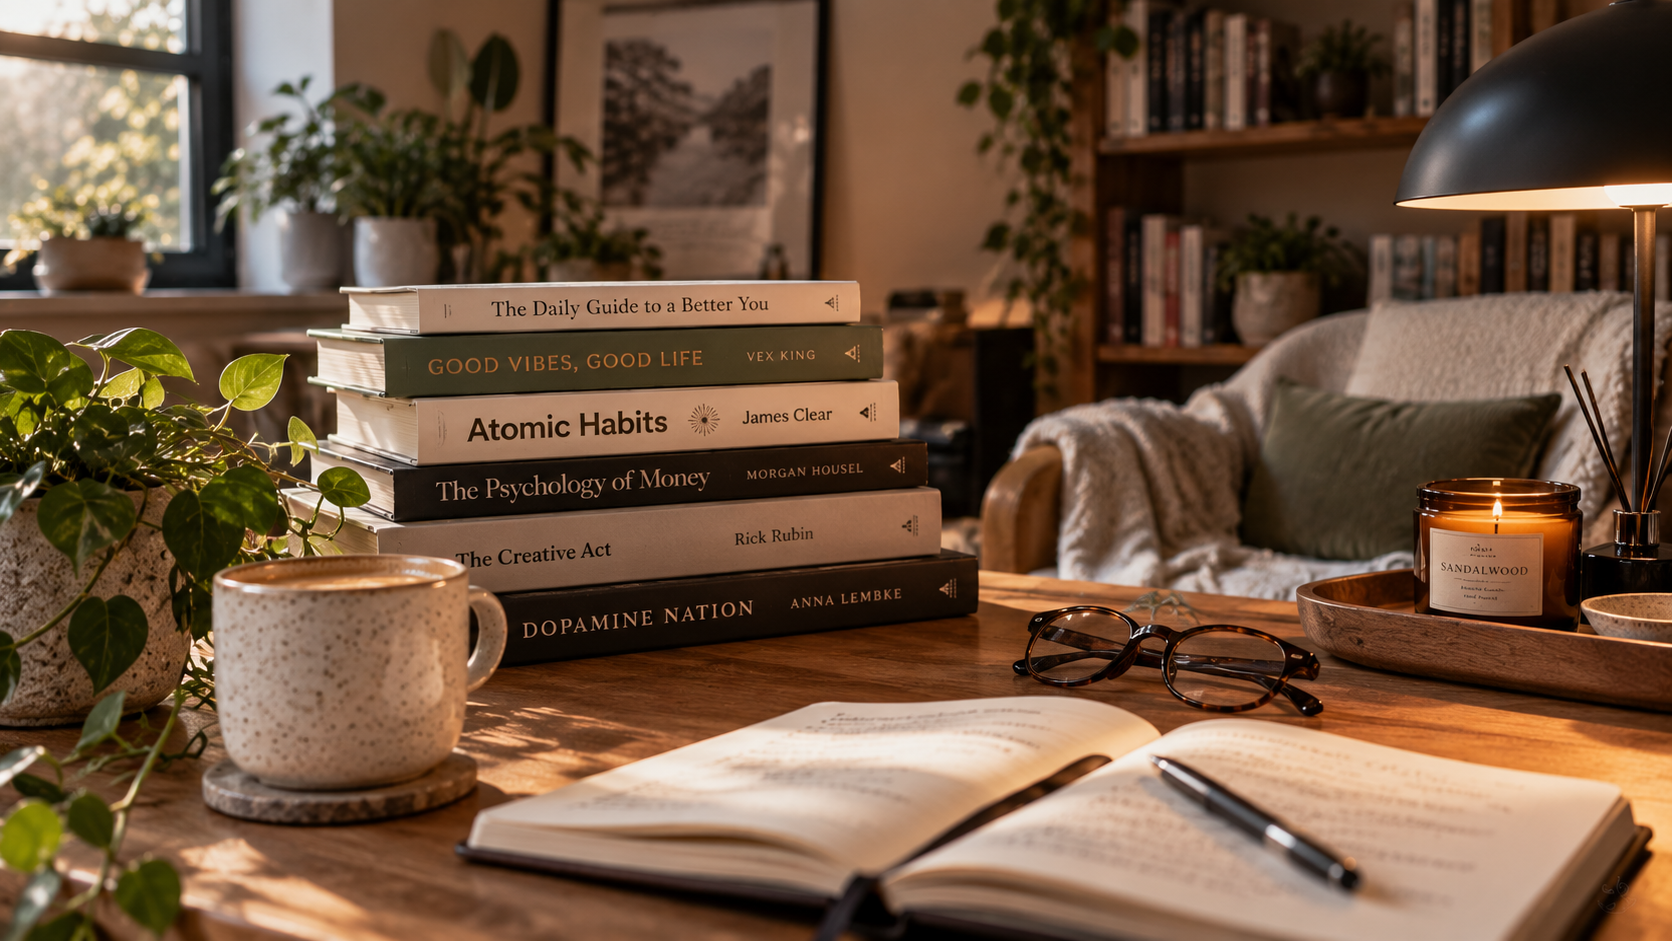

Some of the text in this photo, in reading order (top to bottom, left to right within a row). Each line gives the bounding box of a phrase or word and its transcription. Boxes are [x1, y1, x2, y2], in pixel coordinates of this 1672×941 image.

[490, 296, 769, 321] The Daily Guide to a Better You
[427, 349, 703, 376] GOOD VIBES, GOOD LIFE
[746, 349, 816, 362] VEX KING
[466, 413, 571, 443] Atomic
[579, 409, 668, 437] Habits
[741, 407, 833, 425] James Clear
[746, 462, 864, 480] MORGAN HOUSEL
[435, 468, 711, 504] The Psychology of Money
[734, 526, 814, 546] Rick Rubin
[456, 542, 612, 568] The Creative Act
[1440, 561, 1529, 576] SANDALWOOD
[790, 587, 902, 610] ANNA LEMBKE
[522, 599, 753, 639] DOPAMINE NATION
